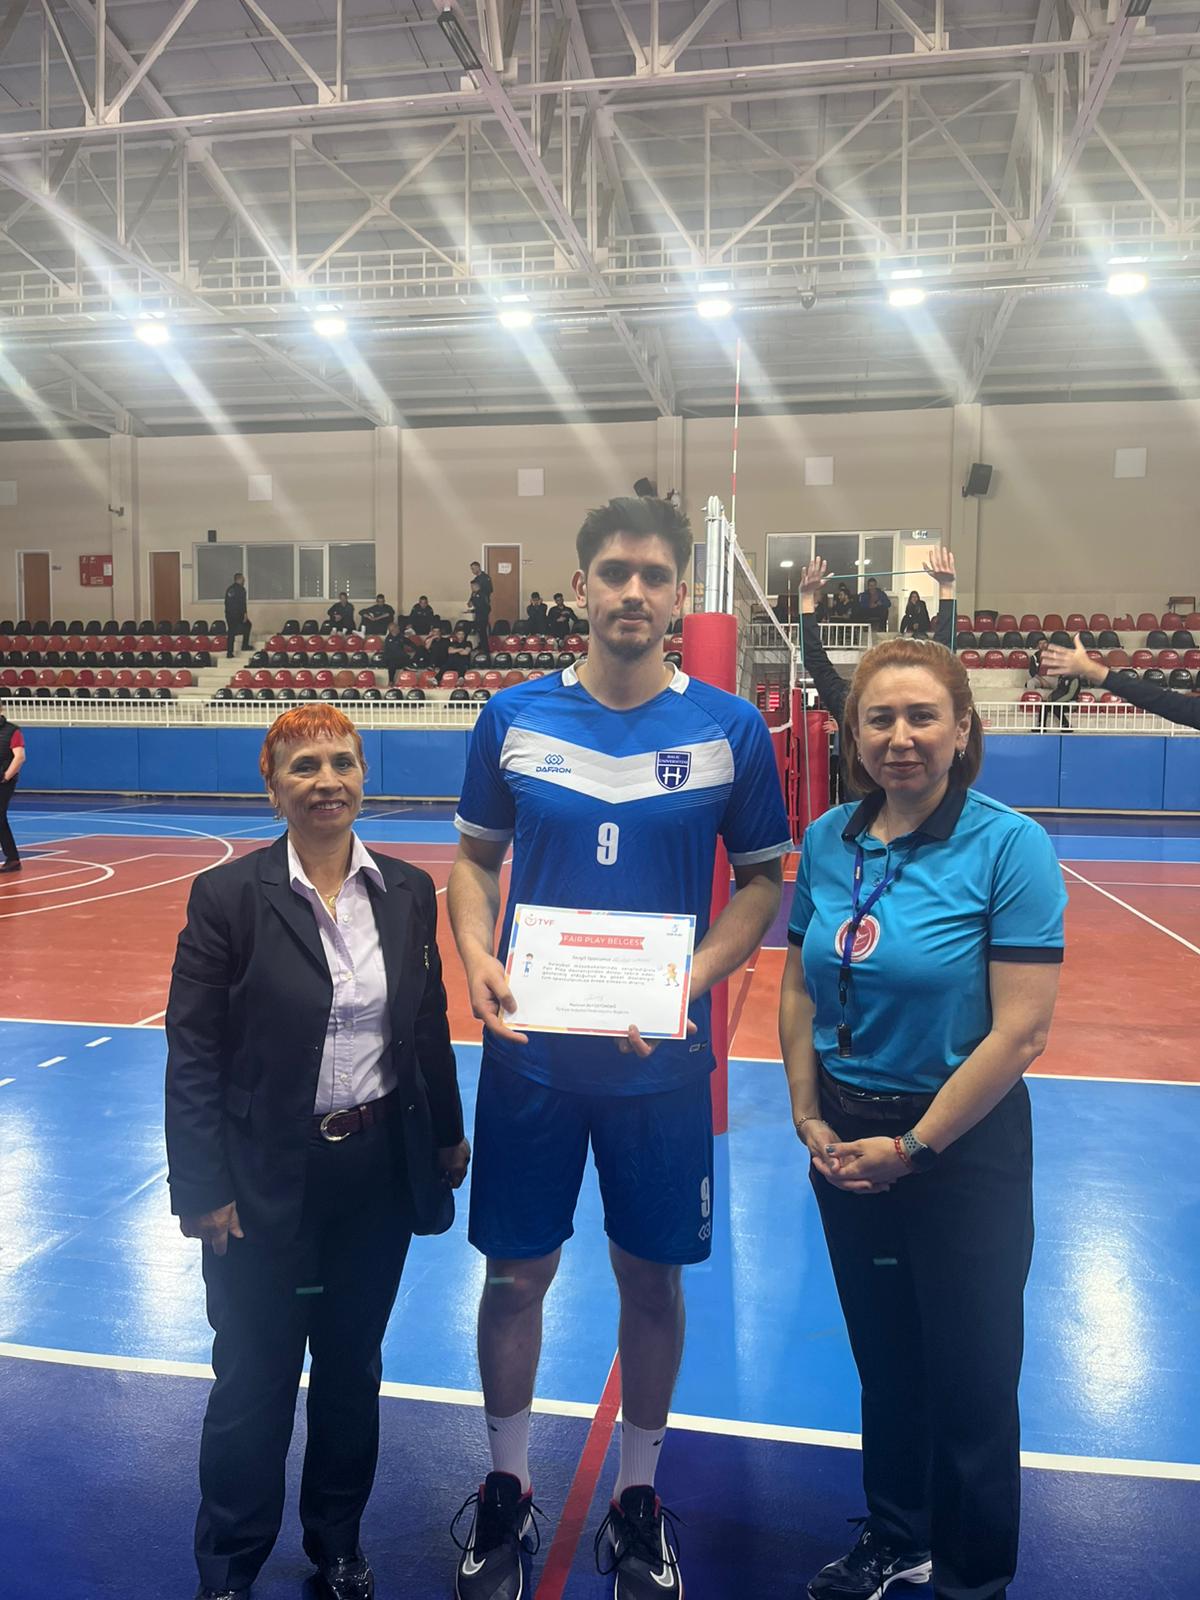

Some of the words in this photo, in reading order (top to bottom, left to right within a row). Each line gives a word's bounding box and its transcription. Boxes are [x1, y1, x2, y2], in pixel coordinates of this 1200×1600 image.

[535, 766, 572, 774] DAFRON
[596, 822, 619, 865] 9
[538, 918, 555, 927] TVF
[563, 934, 583, 943] FAIR
[584, 936, 608, 945] PLAY
[700, 1176, 711, 1218] 9
